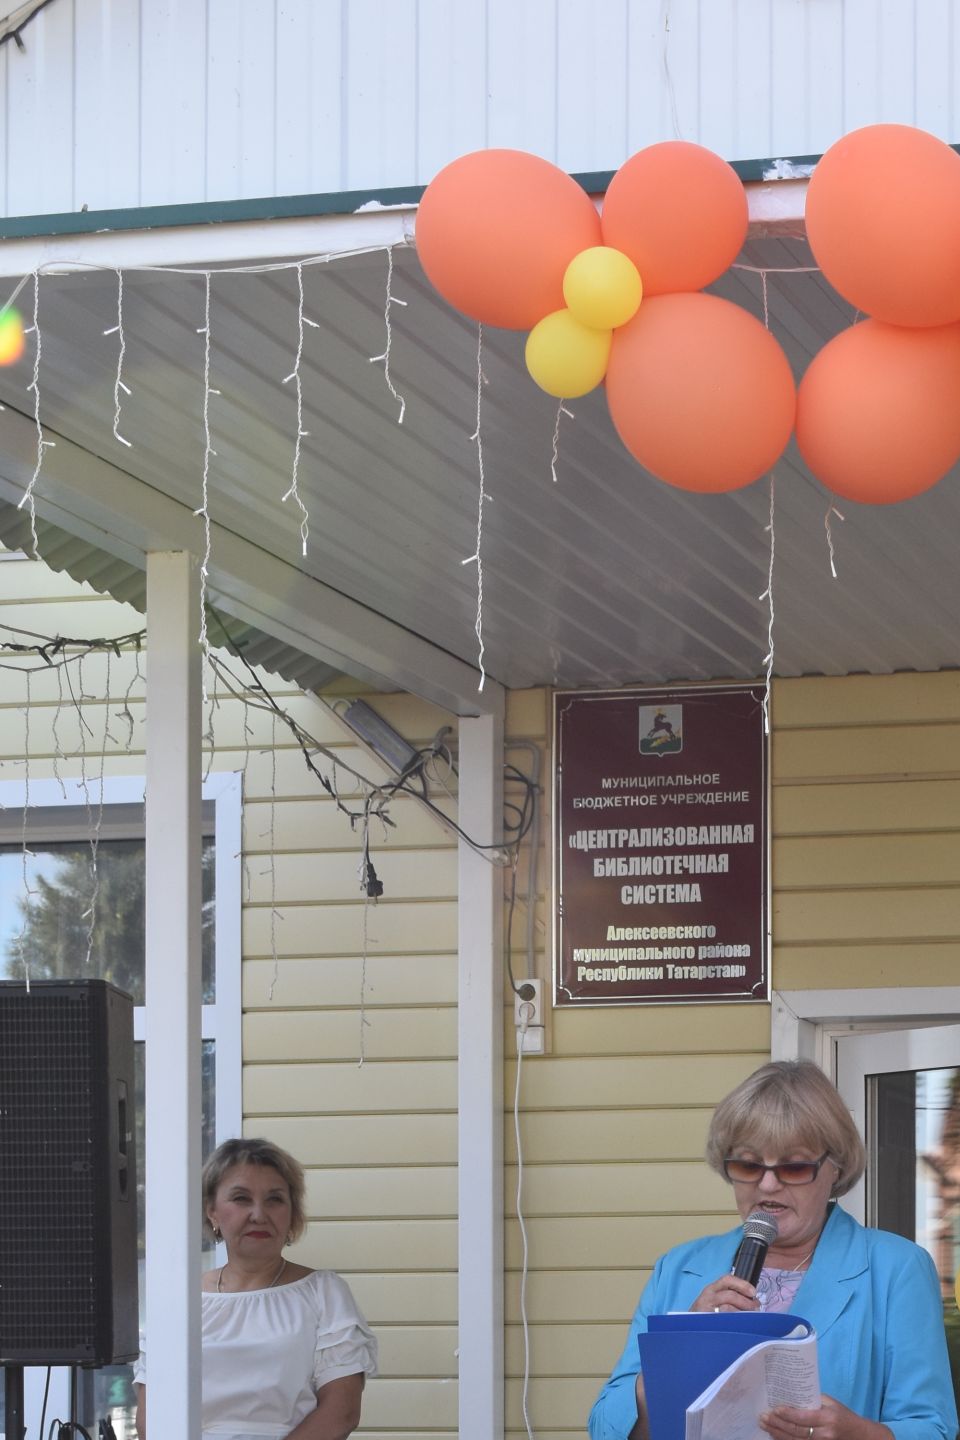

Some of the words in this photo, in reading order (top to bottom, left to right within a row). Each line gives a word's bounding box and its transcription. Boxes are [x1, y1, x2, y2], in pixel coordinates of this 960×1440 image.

[601, 774, 720, 789] МУНИЦИПАЛЬНОЕ
[573, 795, 657, 810] БЮДЖЕТНОЕ
[660, 791, 750, 806] УЧРЕЖДЕНИЕ
[569, 824, 755, 851] «ЦЕНТРАЛИЗОВАННАЯ
[593, 854, 729, 877] БИБЛИОТЕЧНАЯ
[621, 883, 702, 905] СИСТЕМА
[606, 925, 716, 941] Алексеевского
[573, 946, 696, 963] муниципального
[698, 943, 751, 960] района
[578, 965, 663, 982] Республики
[666, 964, 746, 981] Татарстан»
